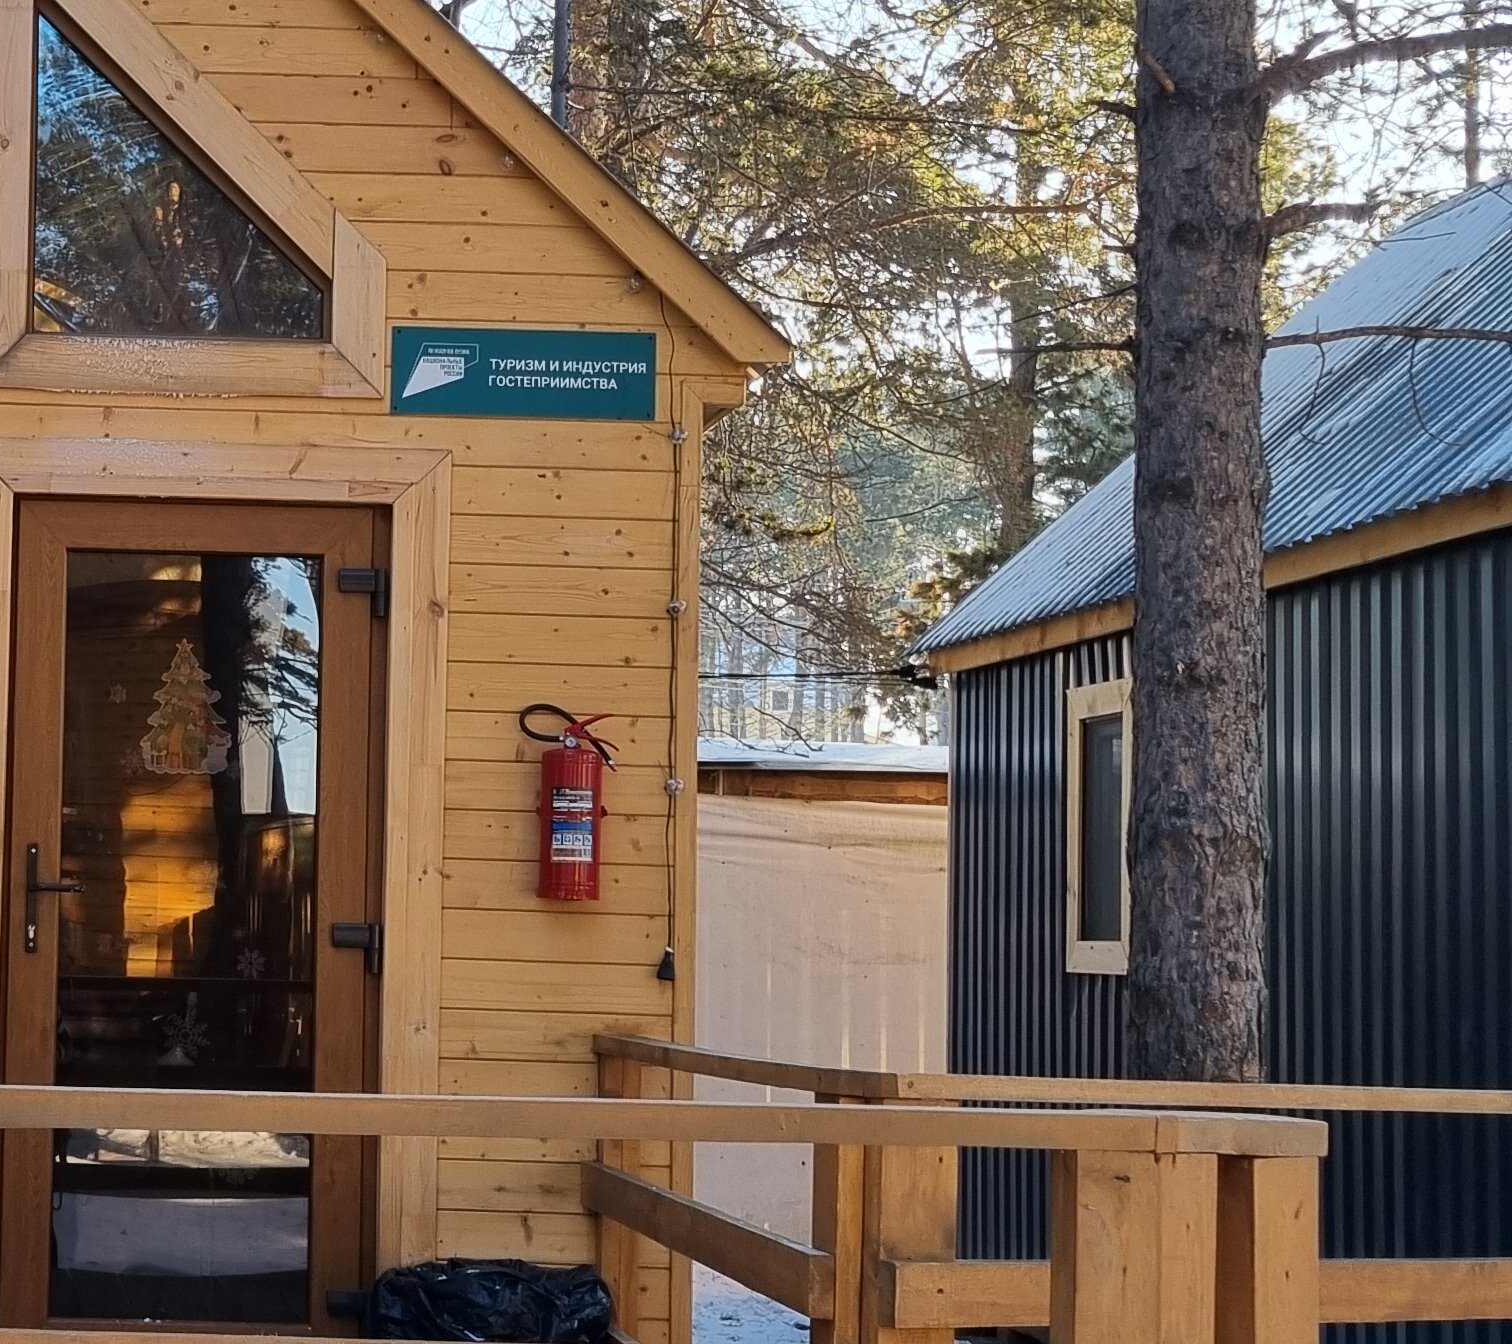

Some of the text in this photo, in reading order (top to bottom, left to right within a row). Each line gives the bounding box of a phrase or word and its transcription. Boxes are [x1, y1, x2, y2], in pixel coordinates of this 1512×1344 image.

[489, 358, 647, 375] ТУРИЗМ И ИНДУСТРИЯ
[488, 375, 618, 390] ГОСТЕПРИИМСТВА
